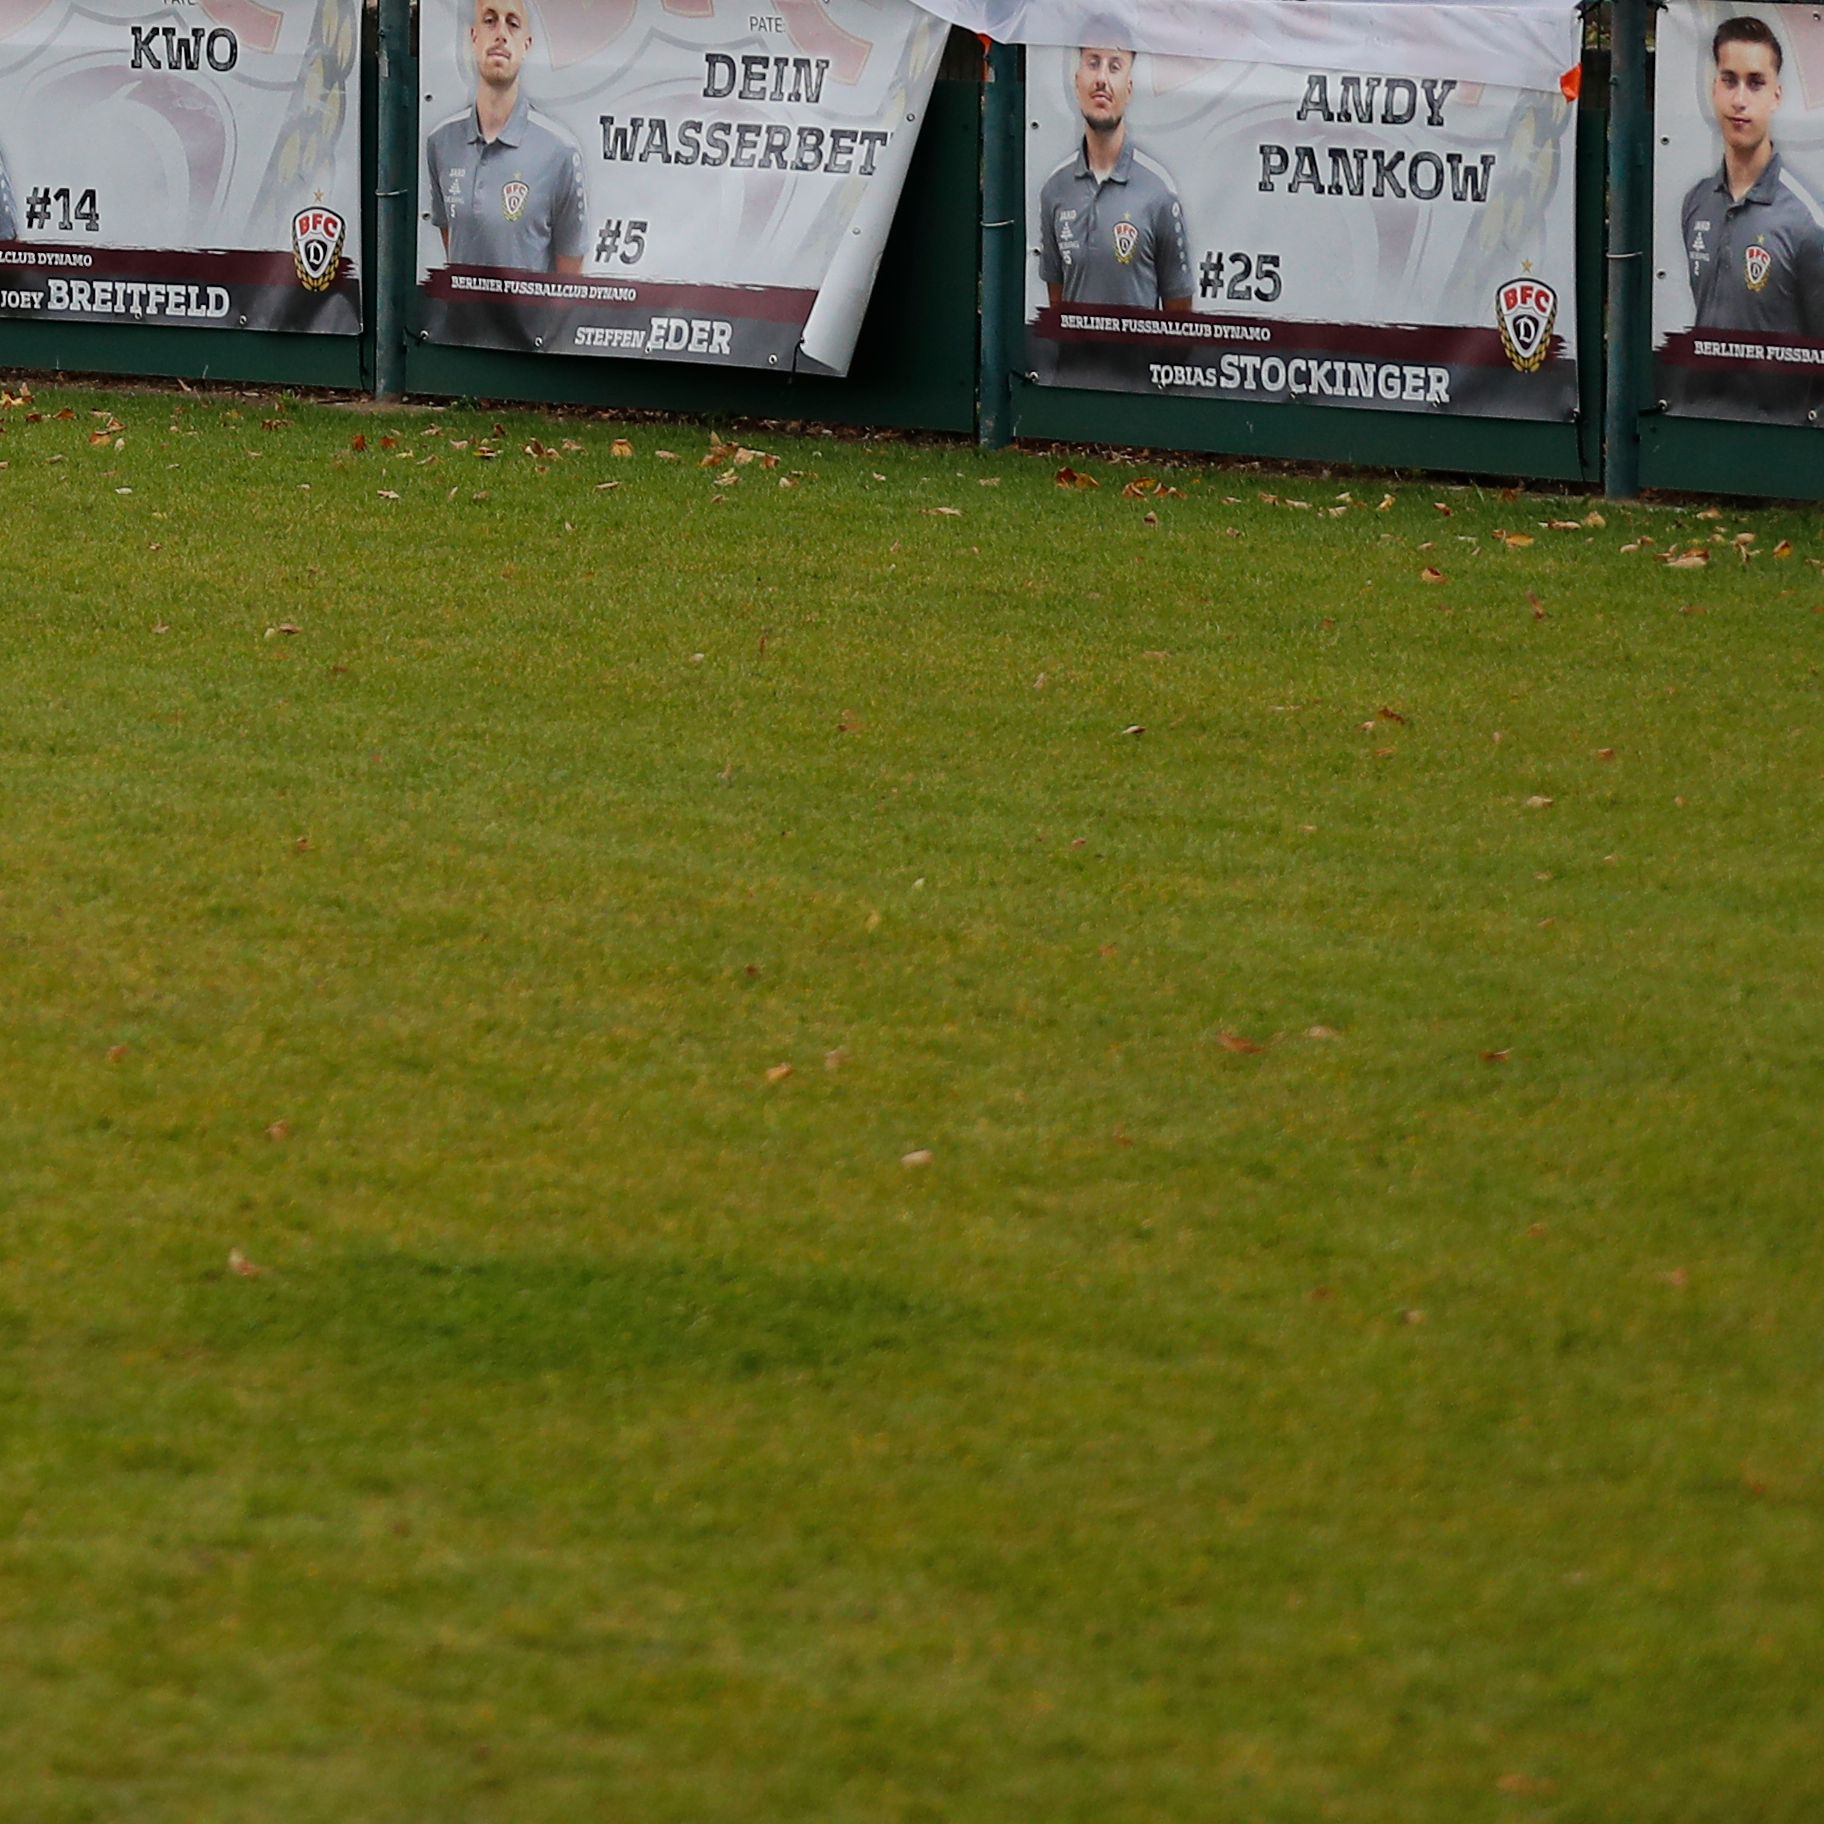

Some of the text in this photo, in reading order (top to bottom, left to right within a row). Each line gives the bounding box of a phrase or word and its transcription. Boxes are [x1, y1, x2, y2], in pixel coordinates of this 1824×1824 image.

[130, 26, 239, 71] KWO
[703, 53, 830, 104] DEIN
[1296, 74, 1456, 126] ANDY
[599, 114, 894, 176] WASSERBET
[1258, 144, 1495, 202] PANKOW
[26, 187, 100, 232] #14
[298, 213, 338, 238] BFC
[38, 253, 92, 267] DYNAMO
[594, 219, 648, 265] #5
[0, 279, 229, 318] JOEY BREITFELD
[451, 276, 636, 302] BERLINER FUSSBALLCLUB DYNAMO
[1200, 251, 1282, 303] #25
[1502, 284, 1552, 314] BFC
[574, 316, 732, 355] STEFFEN EDER
[1061, 315, 1271, 341] BERLINER FUSSBALLCLUB DYNAMO
[1694, 341, 1764, 360] BERLINER
[1150, 354, 1451, 404] TOBIAS STOCKINGER
